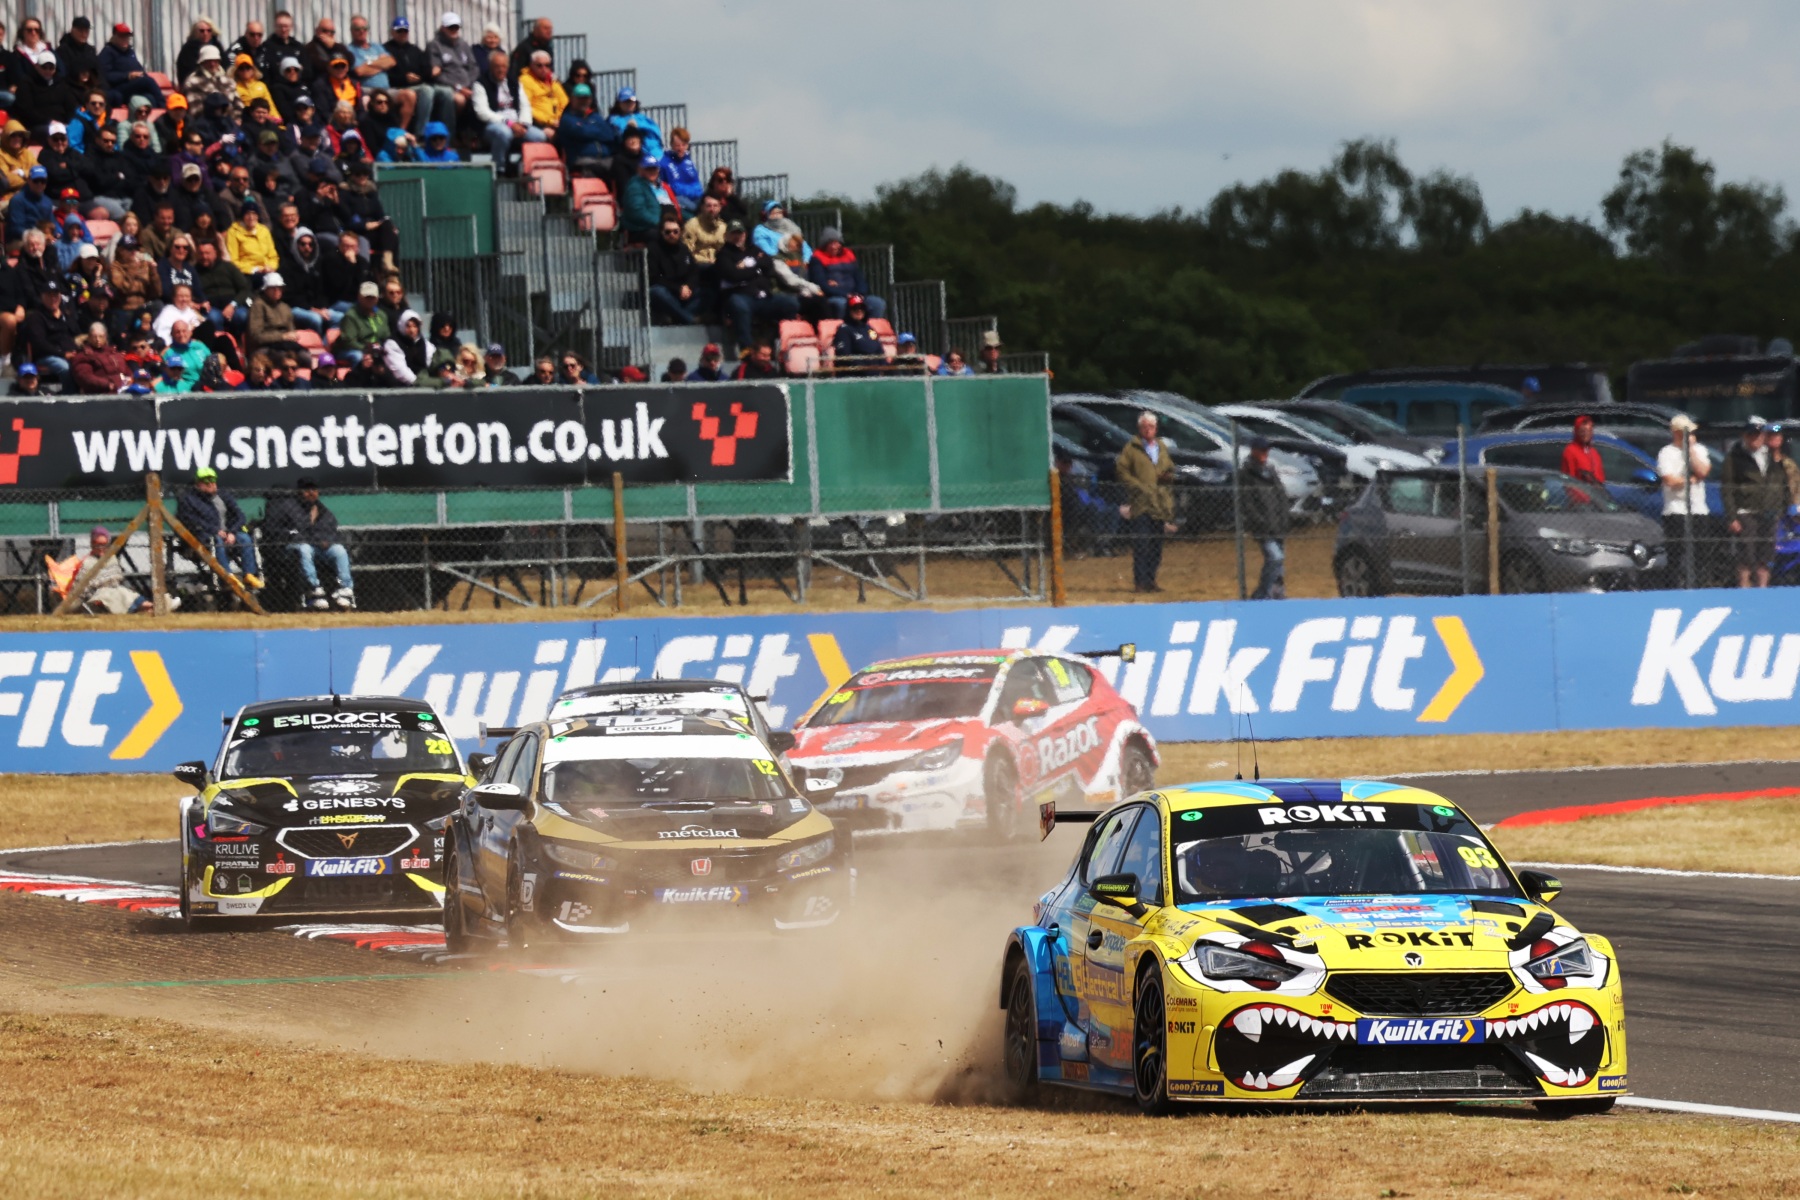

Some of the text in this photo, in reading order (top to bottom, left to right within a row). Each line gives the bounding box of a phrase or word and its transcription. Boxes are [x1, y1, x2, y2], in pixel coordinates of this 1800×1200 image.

[72, 402, 669, 473] www.snetterton.co.uk
[1001, 615, 1426, 716] wikFit
[273, 712, 400, 729] ESIDOCK
[311, 722, 401, 730] www.esidock.com
[425, 739, 453, 755] 28
[1038, 715, 1099, 775] Razor
[752, 759, 779, 776] 12
[303, 797, 406, 811] GENESYS
[1257, 805, 1386, 826] ROKiT
[657, 824, 740, 839] metclad
[215, 843, 260, 855] KRULIVE
[1457, 846, 1499, 870] 93
[311, 859, 377, 876] KwikFit
[791, 866, 832, 880] GOODYEAR
[559, 872, 606, 883] GOODYEAR
[662, 886, 732, 904] KwikFit
[1341, 911, 1444, 920] Brigade
[1346, 932, 1473, 950] ROKiT
[1367, 1019, 1463, 1044] KwikFit
[1170, 1081, 1218, 1094] GOODYEAR
